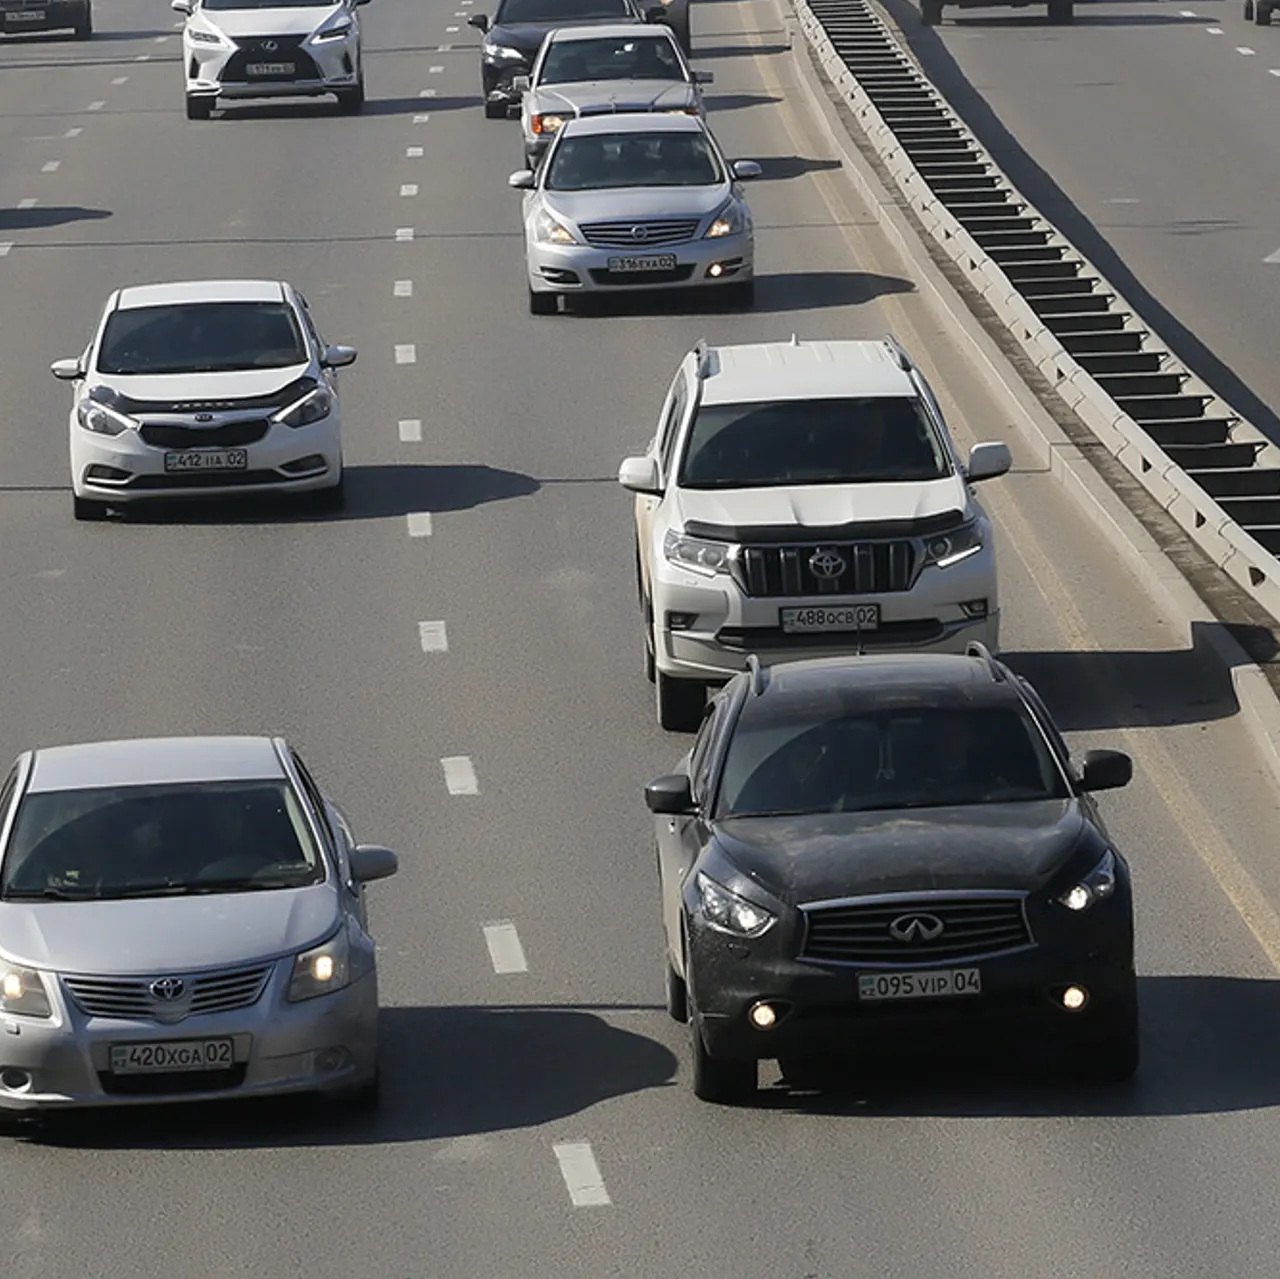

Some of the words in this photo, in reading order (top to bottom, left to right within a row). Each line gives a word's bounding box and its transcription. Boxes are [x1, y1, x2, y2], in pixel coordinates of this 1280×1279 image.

[856, 607, 876, 623] 02
[955, 971, 979, 991] 04
[206, 1043, 230, 1062] 02
